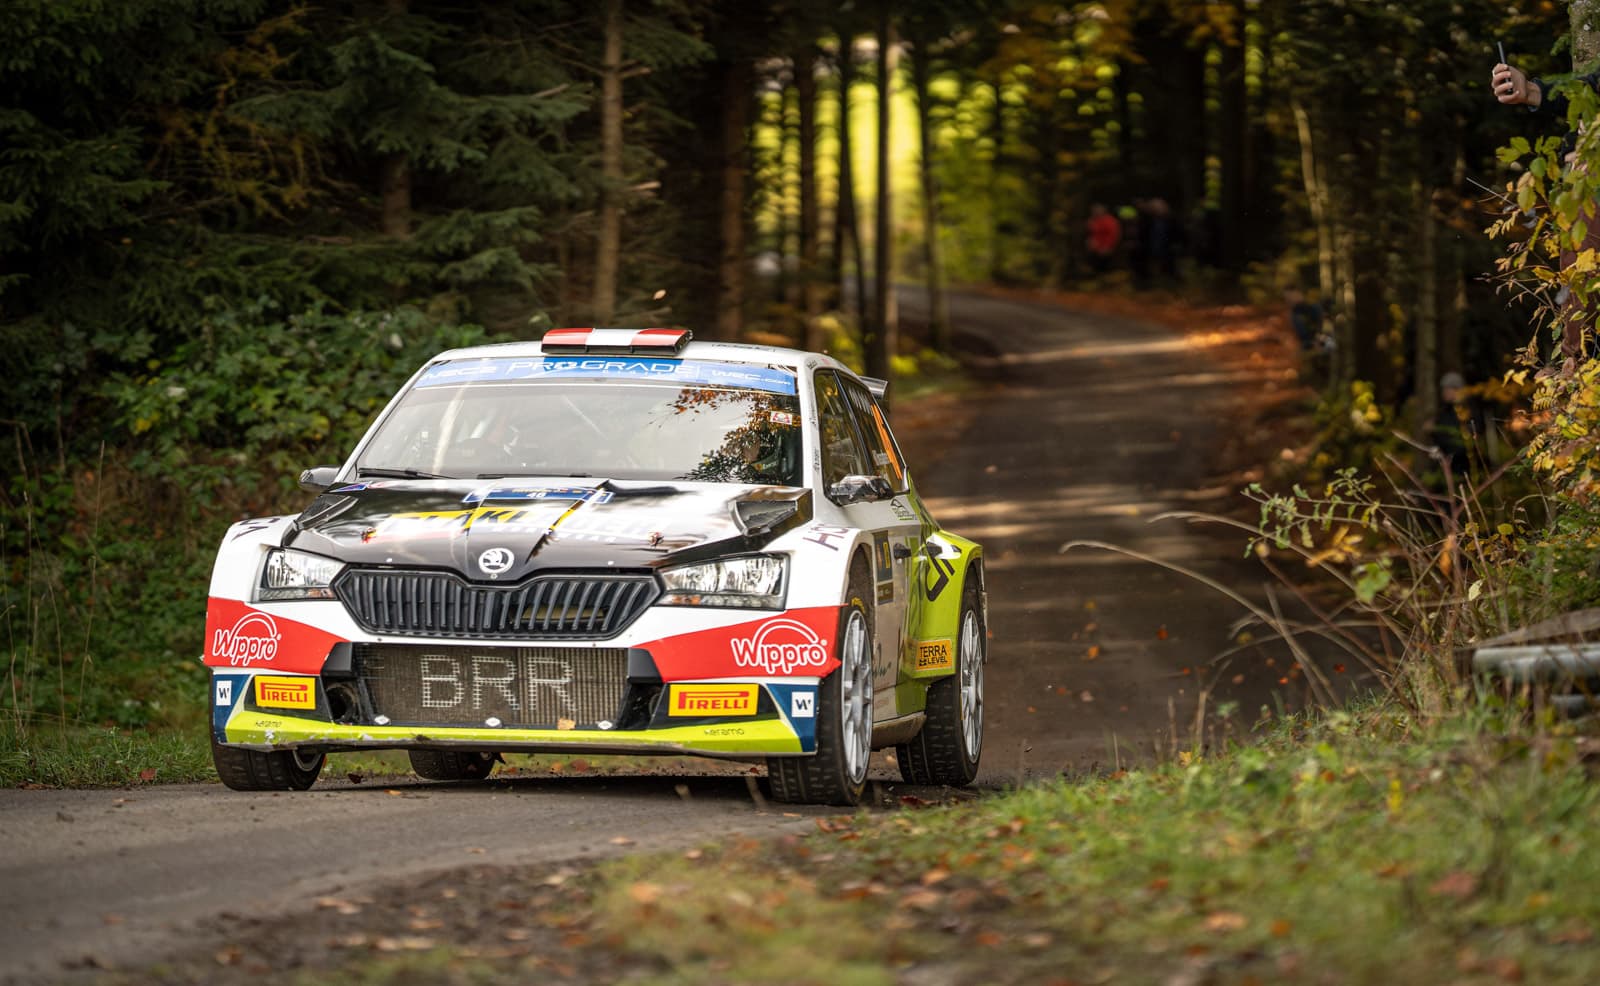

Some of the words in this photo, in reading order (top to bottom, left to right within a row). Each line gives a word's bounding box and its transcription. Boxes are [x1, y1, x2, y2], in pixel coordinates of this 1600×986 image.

[505, 360, 695, 376] PROGRADE
[212, 612, 281, 666] Wippro
[730, 618, 828, 674] Wippro
[919, 645, 947, 657] TERRA
[260, 682, 308, 702] PIRELLI
[421, 655, 577, 711] BRR
[678, 691, 750, 710] PIRELLI
